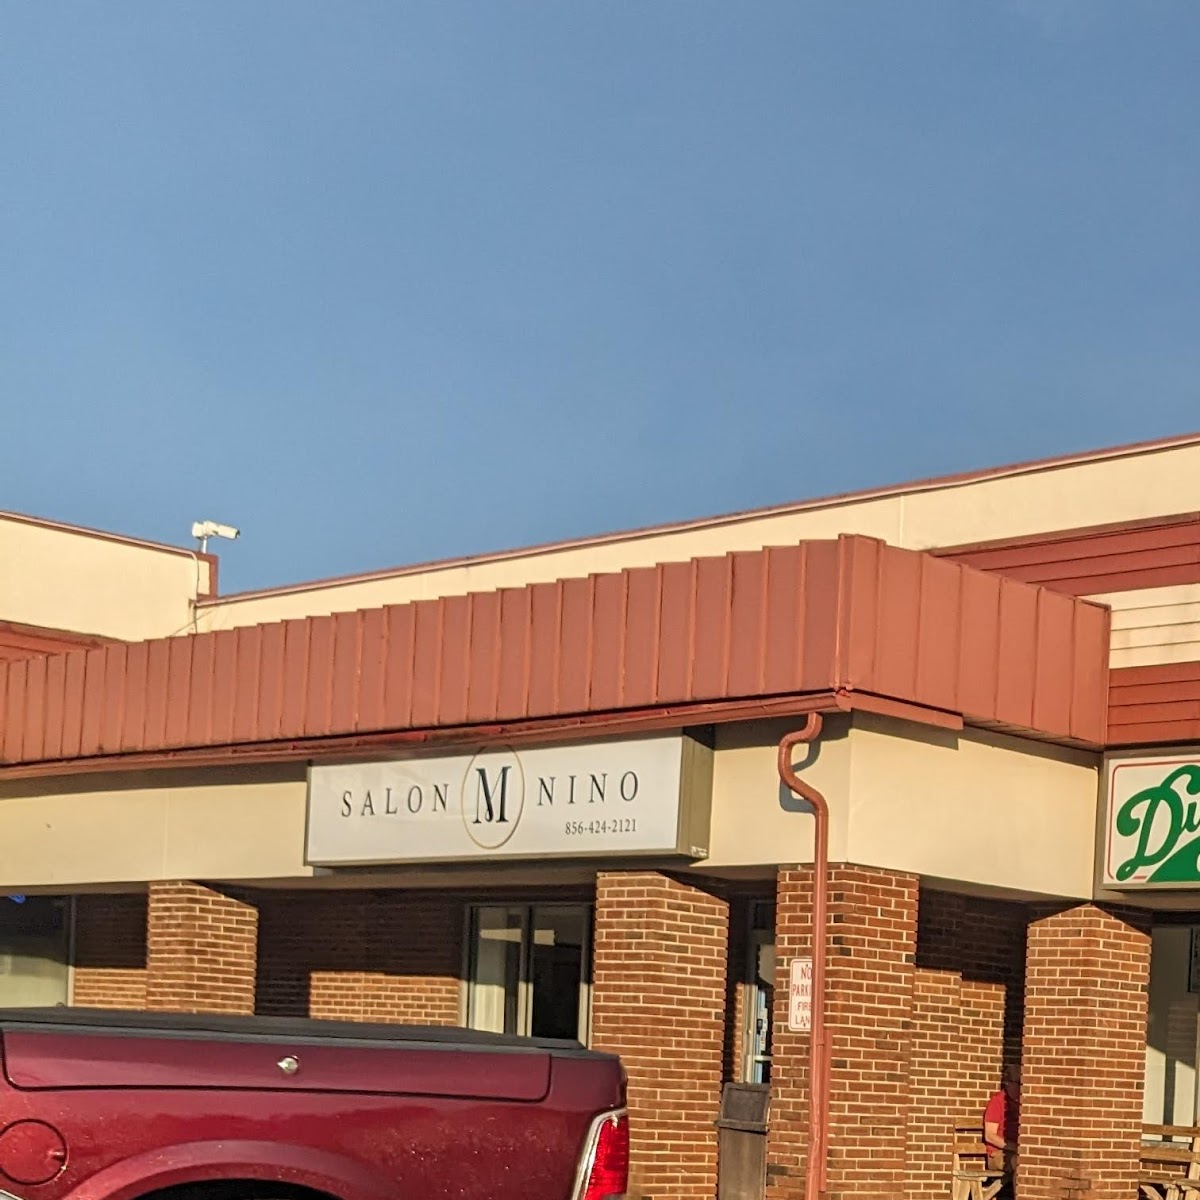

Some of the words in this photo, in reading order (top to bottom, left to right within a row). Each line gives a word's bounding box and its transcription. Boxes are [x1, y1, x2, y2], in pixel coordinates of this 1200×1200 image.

[341, 783, 450, 818] SALON
[472, 765, 513, 825] M
[537, 771, 639, 806] NINO
[565, 818, 637, 836] 856-424-2121
[800, 966, 813, 980] NO
[795, 1015, 810, 1025] LAN
